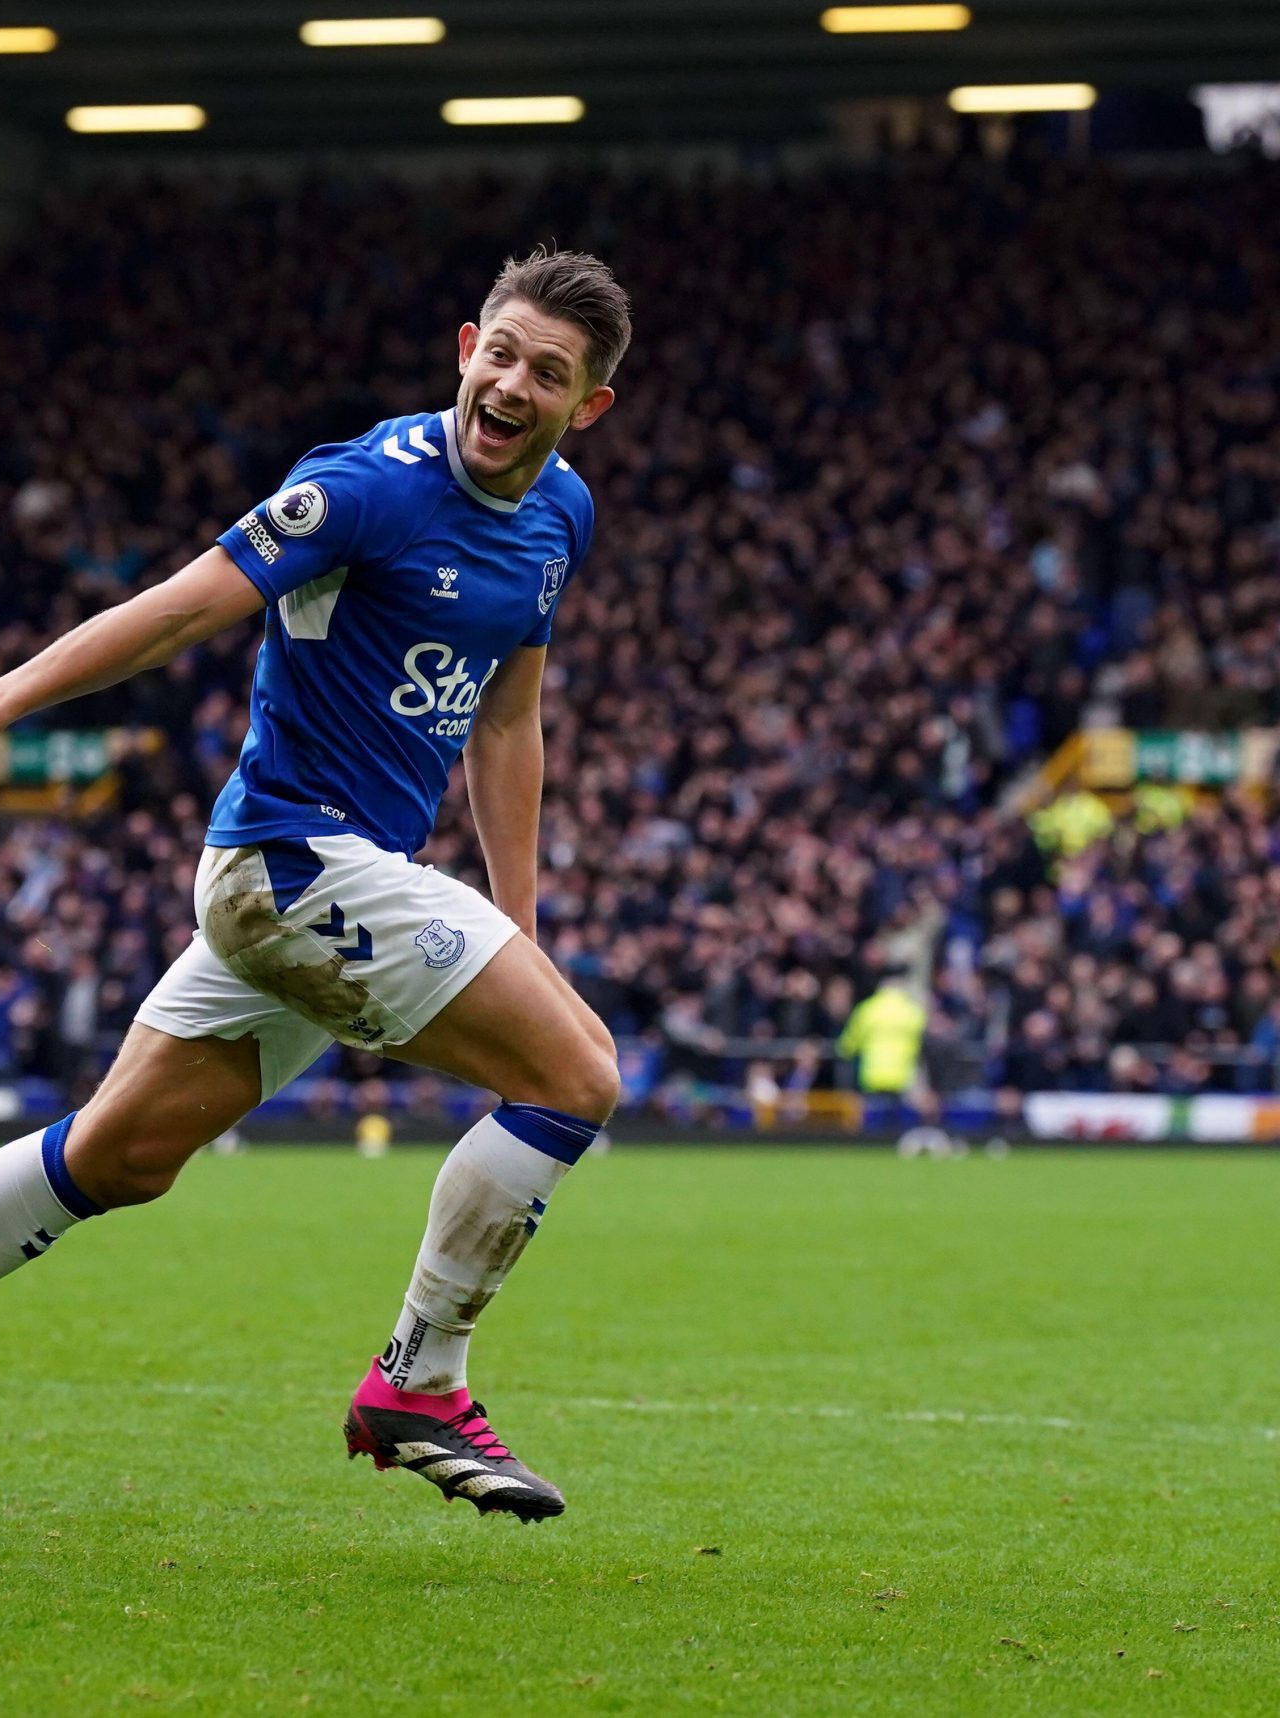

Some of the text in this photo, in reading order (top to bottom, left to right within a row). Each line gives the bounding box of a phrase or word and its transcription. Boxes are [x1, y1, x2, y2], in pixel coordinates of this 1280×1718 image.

[276, 515, 311, 529] Premier League
[246, 528, 275, 565] racism
[255, 524, 280, 555] room
[430, 587, 459, 599] hummel
[428, 717, 470, 737] .com
[434, 939, 454, 957] Everton
[397, 1316, 429, 1375] TAPEDESIG
